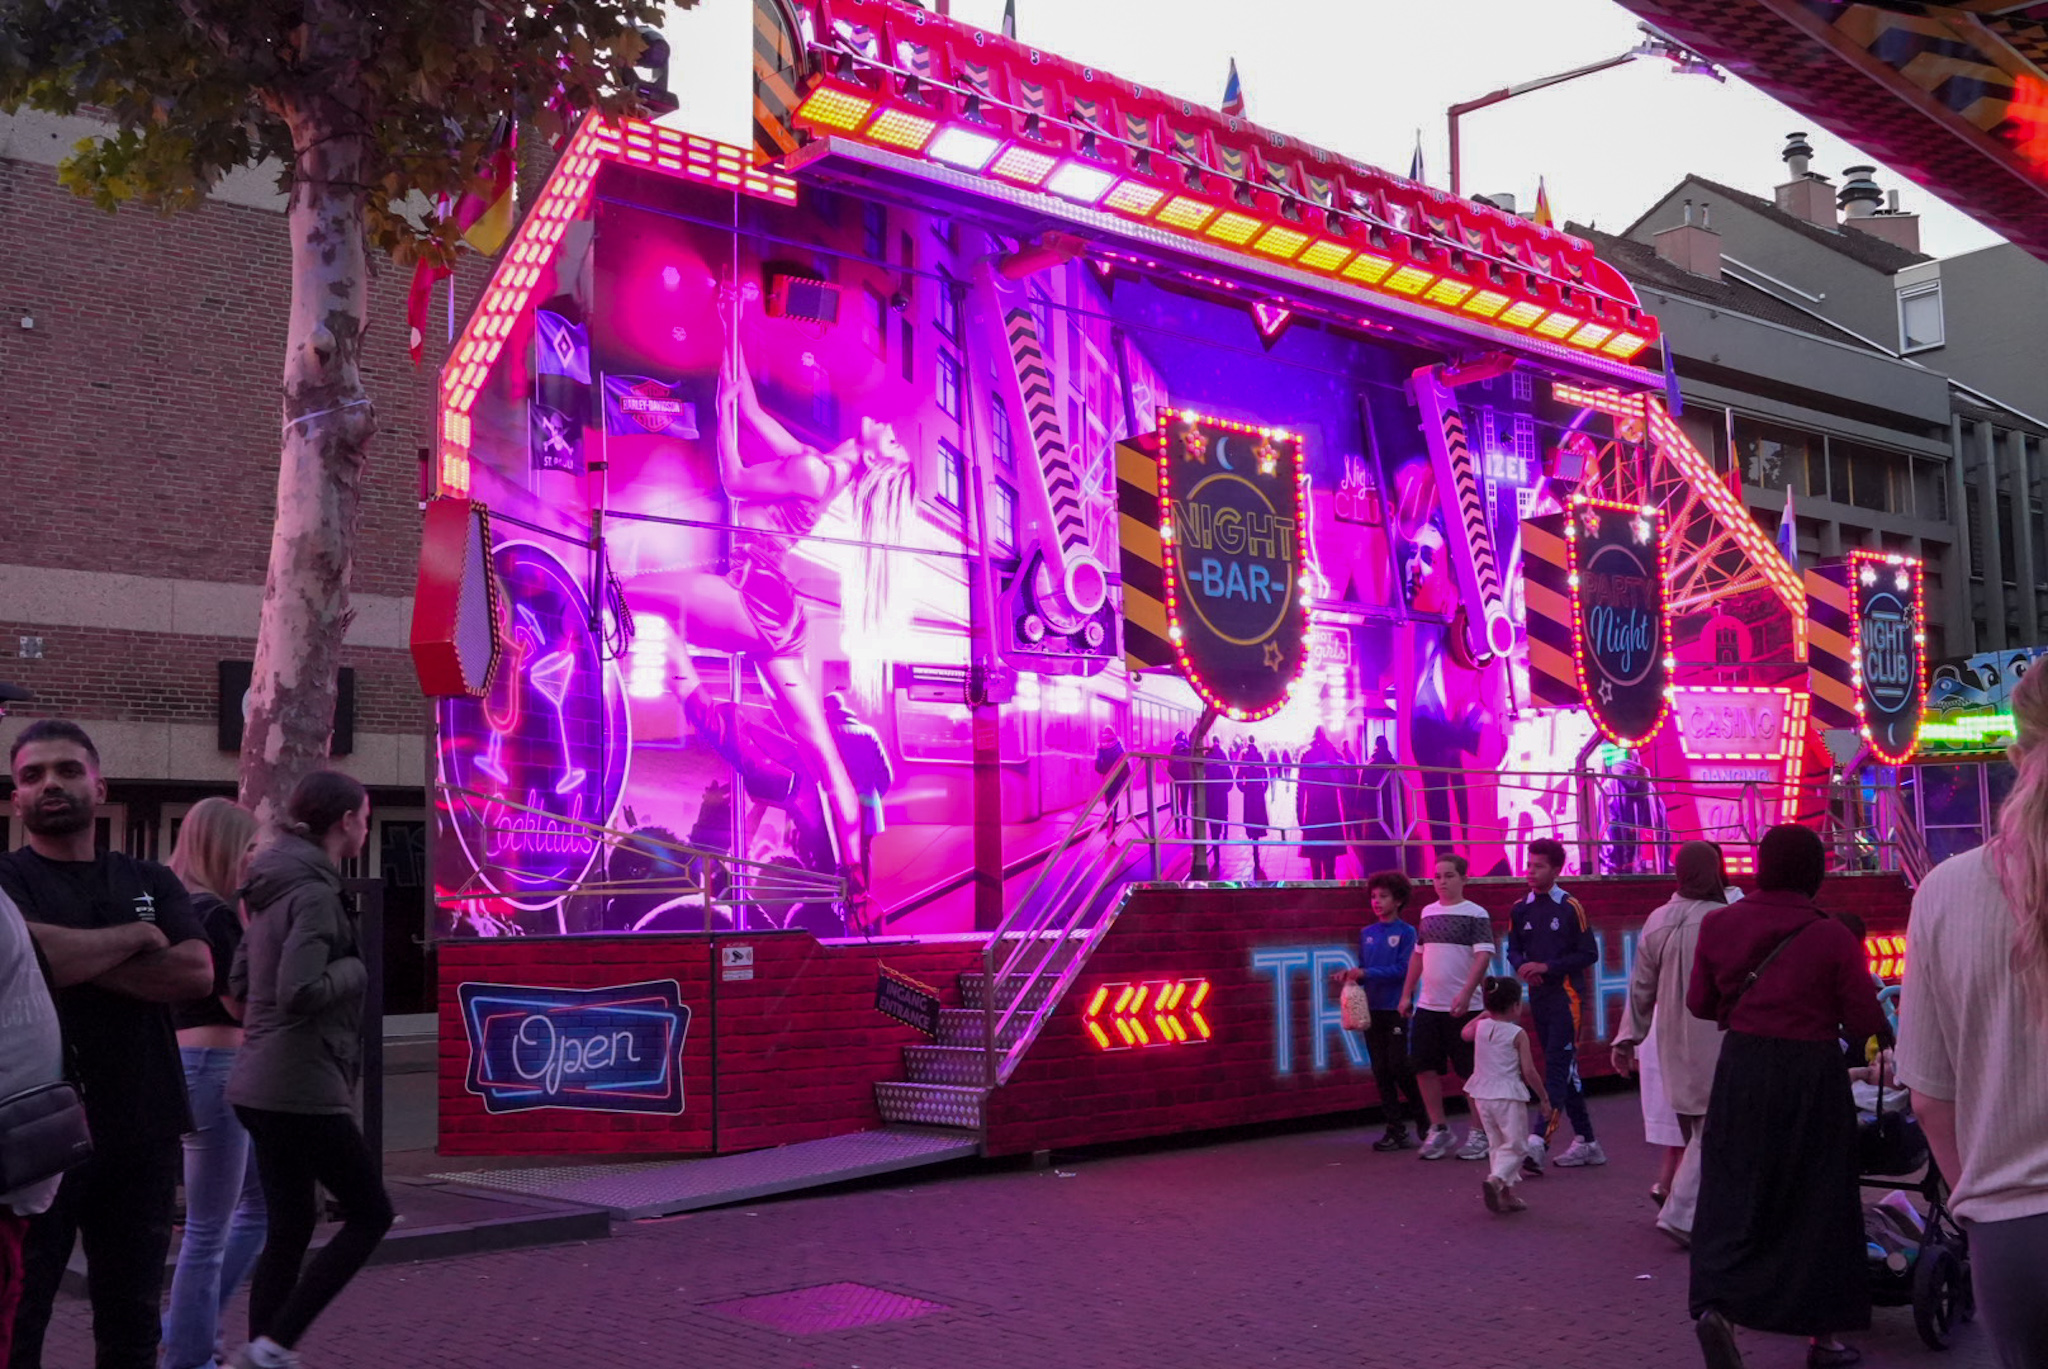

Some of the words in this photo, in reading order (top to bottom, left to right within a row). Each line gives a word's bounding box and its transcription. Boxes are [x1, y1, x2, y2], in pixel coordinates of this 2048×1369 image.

[1031, 49, 1040, 65] 5
[1083, 67, 1093, 82] 6
[1133, 84, 1142, 99] 7
[1182, 102, 1192, 117] 8
[1229, 119, 1238, 133] 9
[1271, 133, 1285, 149] 10
[1315, 149, 1327, 164] 11
[1171, 499, 1296, 562] NIGHT
[1581, 571, 1655, 611] PARTY
[1590, 605, 1650, 673] Night
[1858, 618, 1907, 651] NIGHT
[1867, 650, 1909, 683] CLUB
[1691, 706, 1777, 740] CASINO
[878, 995, 931, 1030] ENTRANCE
[886, 981, 929, 1012] INGANG
[512, 1014, 642, 1095] Open
